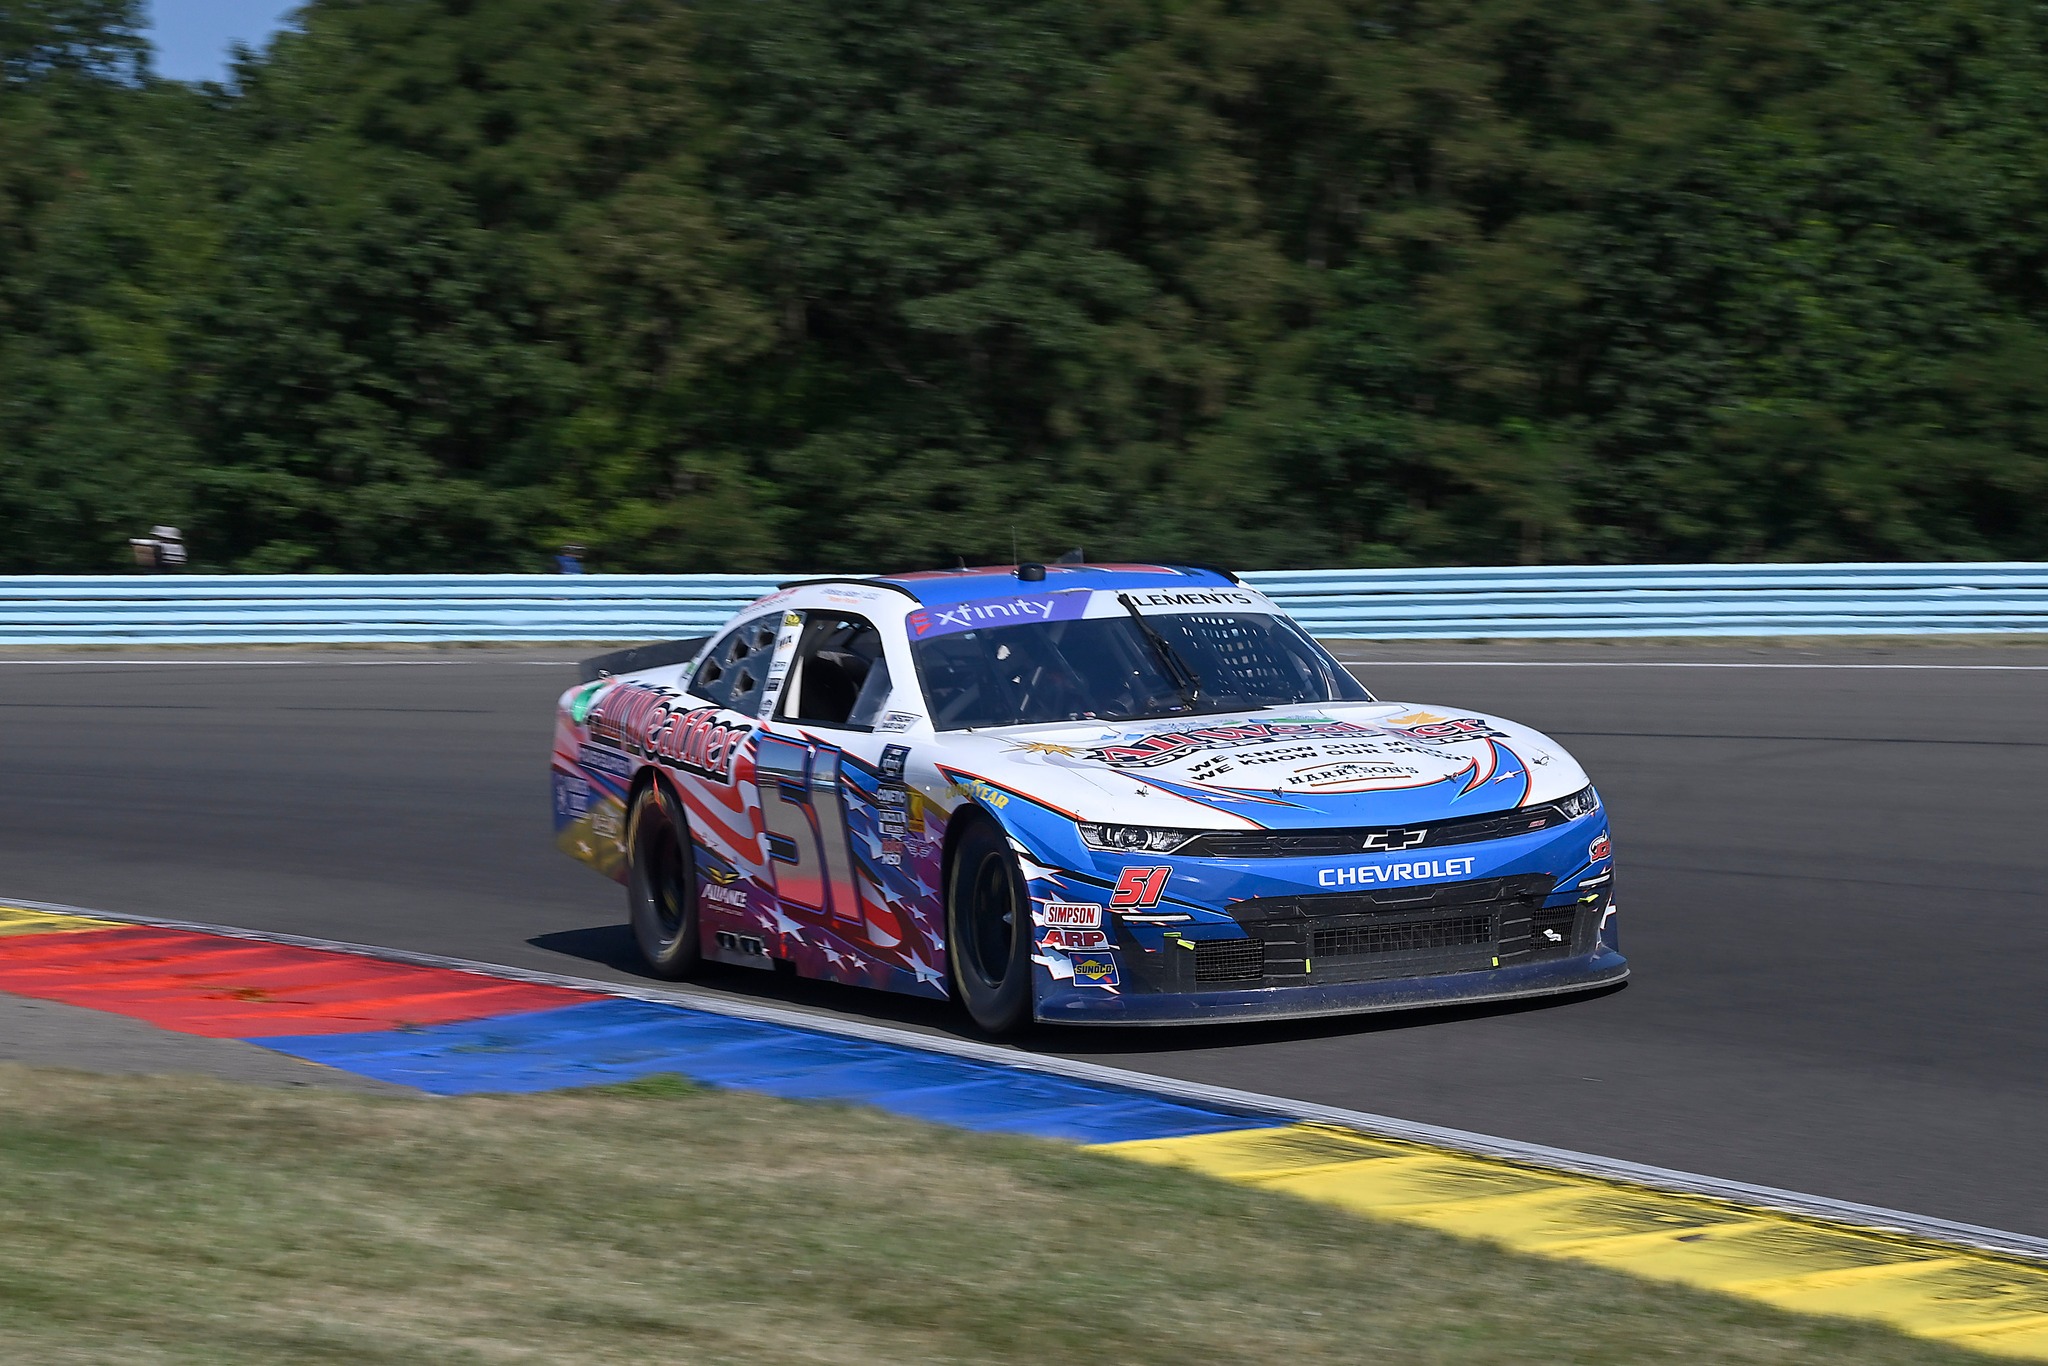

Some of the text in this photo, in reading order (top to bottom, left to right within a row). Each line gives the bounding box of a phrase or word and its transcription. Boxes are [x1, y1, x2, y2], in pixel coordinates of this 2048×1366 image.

[934, 599, 1055, 627] xfinity
[1130, 592, 1252, 607] LEMENTS
[1187, 755, 1229, 772] WE
[1234, 746, 1313, 759] KNOW
[1191, 764, 1234, 781] WE
[1239, 752, 1318, 765] KNOW
[755, 732, 868, 928] 51
[1318, 857, 1475, 886] CHEVROLET
[1110, 866, 1173, 908] 51
[1048, 906, 1096, 924] SIMPSON
[1043, 930, 1106, 947] ARP
[1076, 964, 1112, 974] SUNOCO
